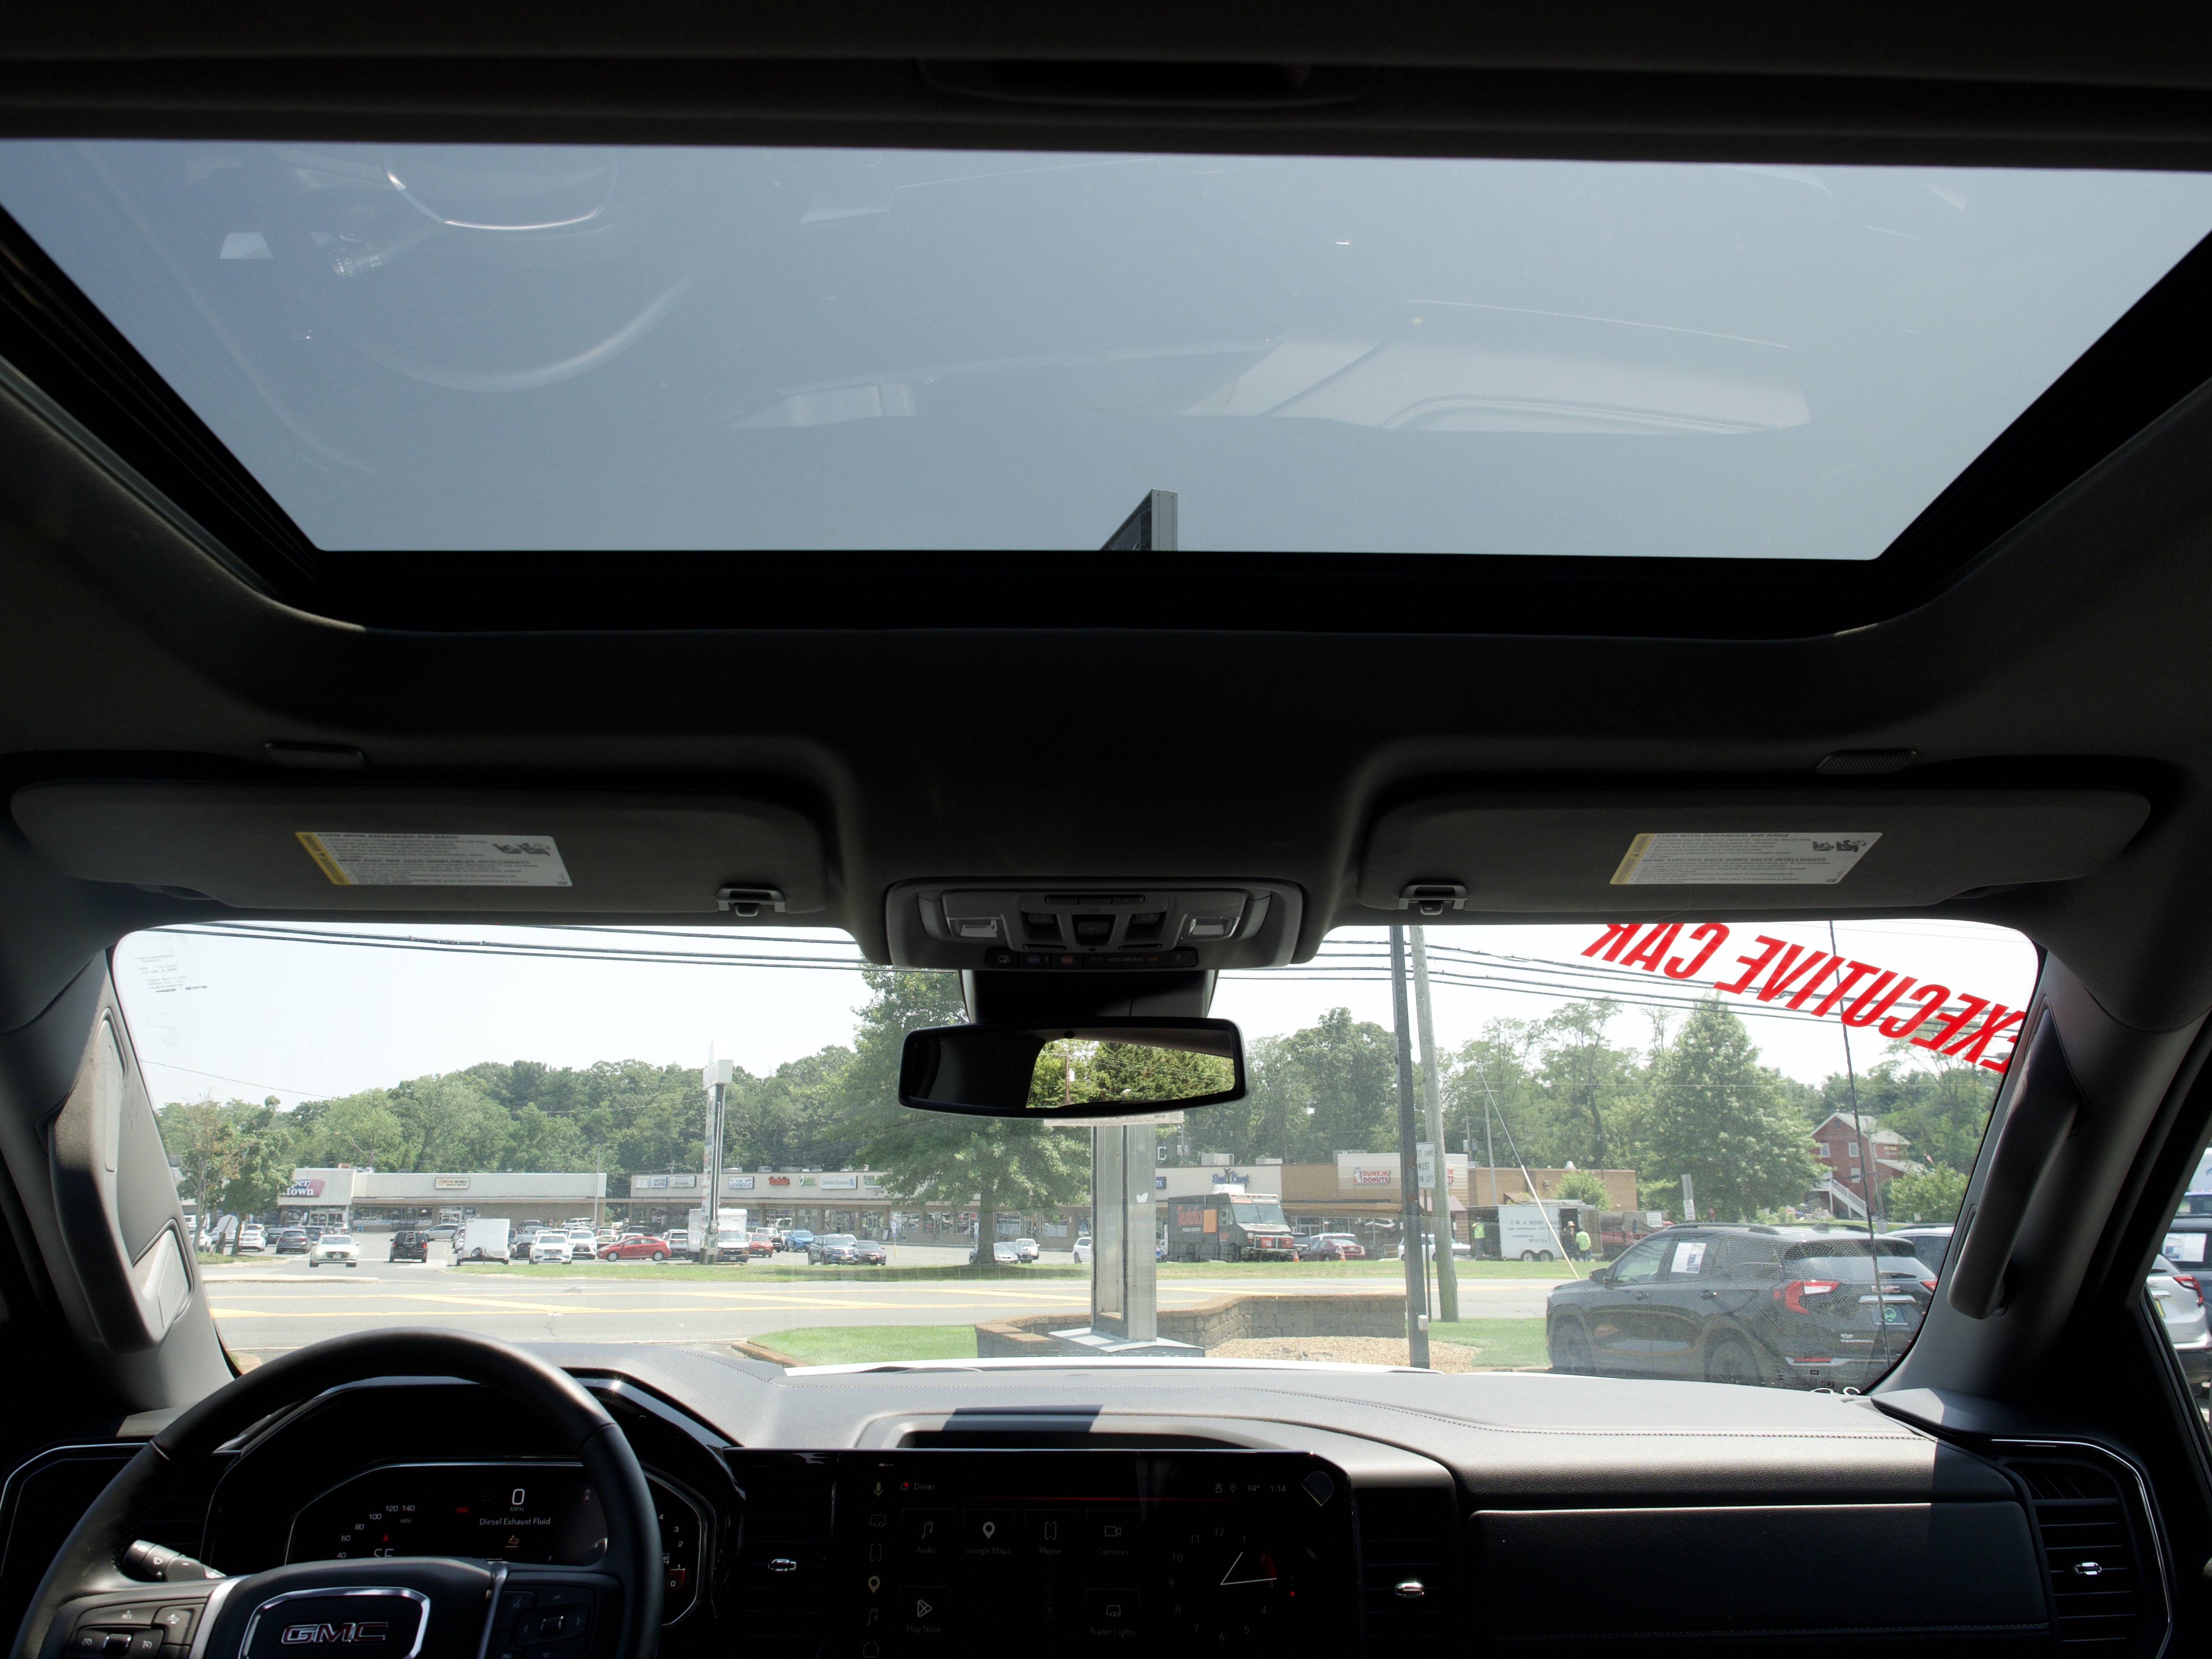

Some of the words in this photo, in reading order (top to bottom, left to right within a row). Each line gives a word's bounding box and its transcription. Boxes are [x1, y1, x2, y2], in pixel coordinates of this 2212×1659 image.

[1418, 1162, 1429, 1170] MUST
[1213, 1173, 1227, 1183] East
[1231, 1173, 1249, 1182] Coast
[512, 1488, 525, 1505] 0
[1215, 1528, 1224, 1537] 12
[1190, 1535, 1199, 1543] 11
[965, 1547, 990, 1556] Google
[992, 1547, 1011, 1556] Maps
[1172, 1554, 1182, 1562] 10
[1260, 1554, 1266, 1563] 2
[1175, 1605, 1181, 1613] 8
[906, 1625, 921, 1634] Play
[1090, 1628, 1114, 1636] Trailer
[1115, 1628, 1136, 1638] Lights
[1194, 1624, 1199, 1633] 7
[1244, 1625, 1249, 1634] 5
[281, 1622, 389, 1645] GMC
[1219, 1633, 1225, 1641] 6
